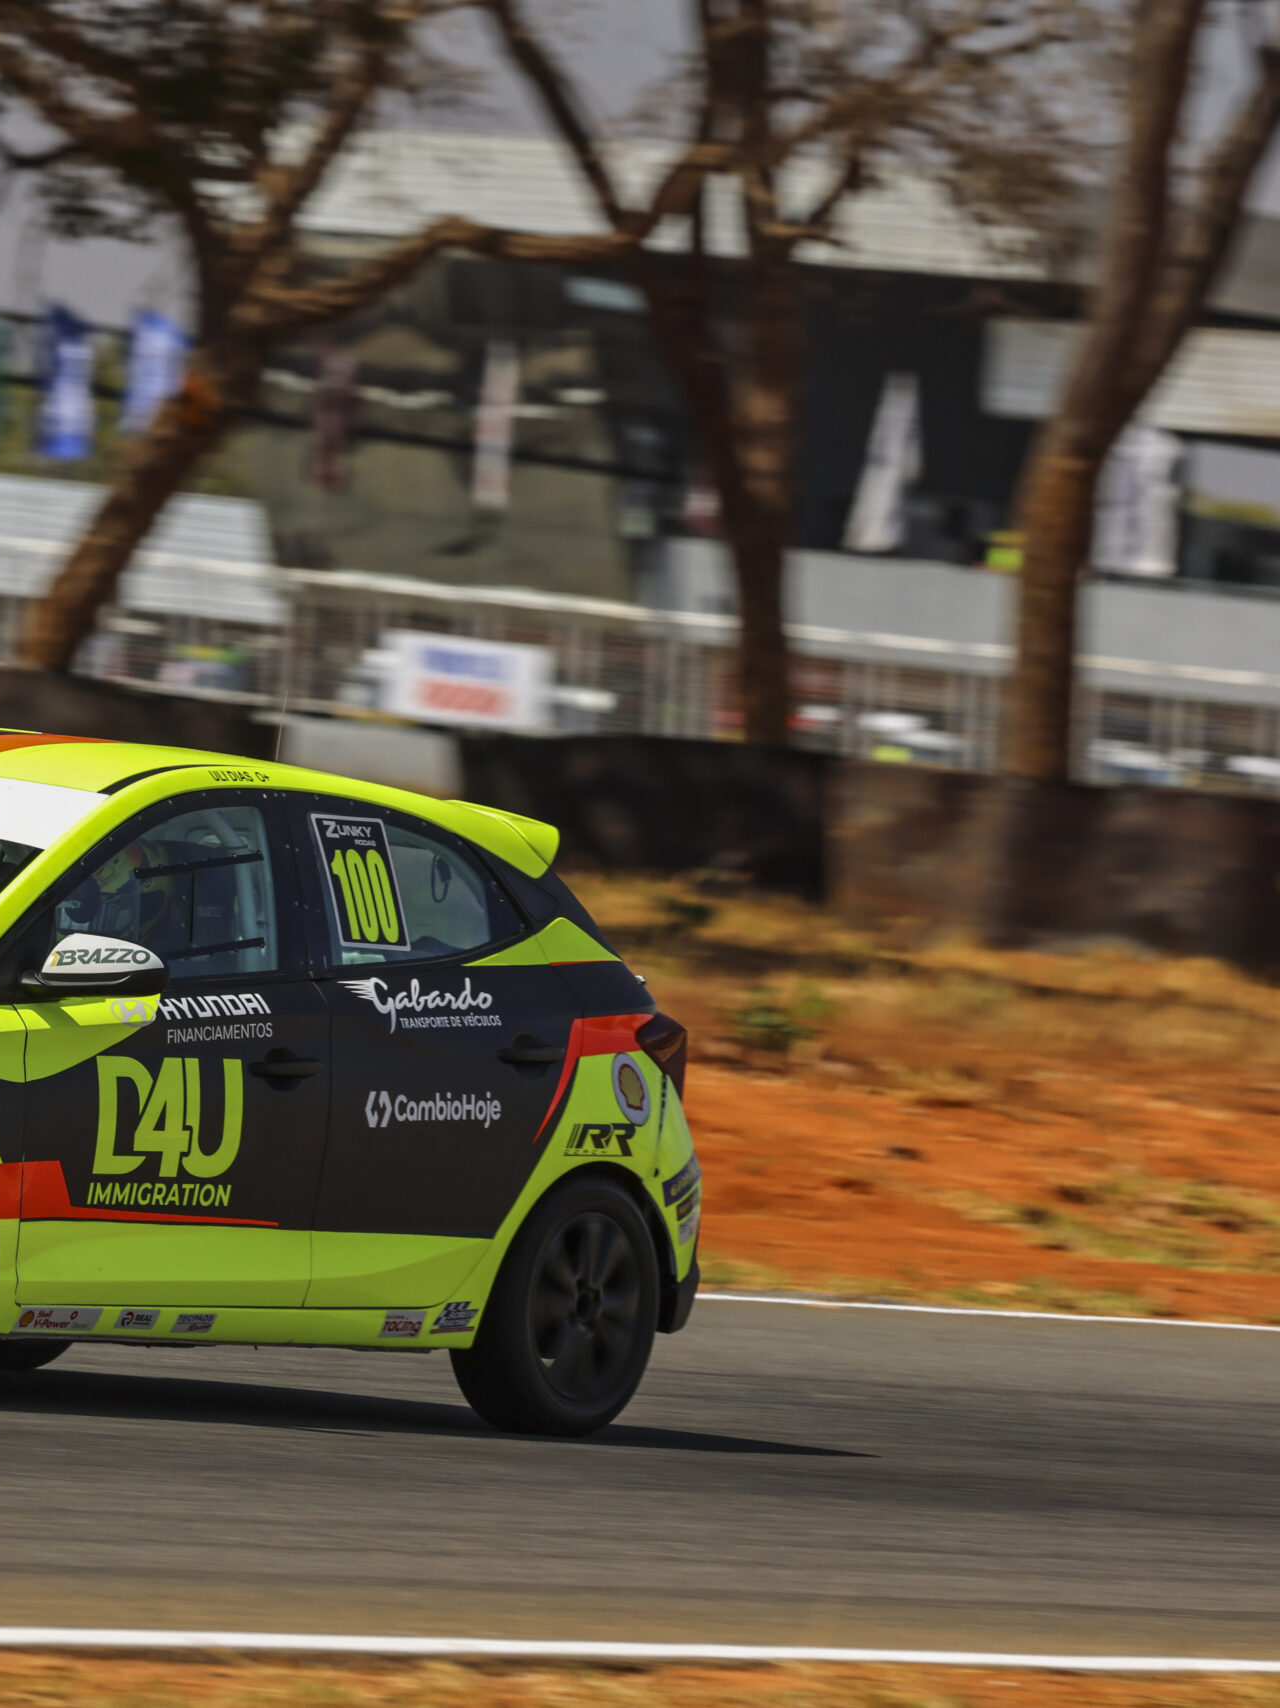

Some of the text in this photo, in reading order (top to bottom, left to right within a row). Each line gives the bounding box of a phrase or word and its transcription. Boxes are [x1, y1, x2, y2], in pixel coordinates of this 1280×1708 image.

[207, 770, 229, 782] ULI
[226, 770, 254, 782] DIAS
[322, 820, 372, 839] ZUNKY
[331, 848, 400, 944] 100
[52, 947, 152, 967] BRAZZO
[155, 992, 272, 1021] HYUNDAI
[368, 976, 494, 1034] Gabardo
[166, 1022, 274, 1044] FINANCIAMENTOS
[399, 1015, 451, 1029] TRANSPORTE
[450, 1015, 462, 1028] DE
[91, 1054, 245, 1179] D4U
[393, 1091, 503, 1129] CambioHoje
[86, 1181, 233, 1208] IMMIGRATION
